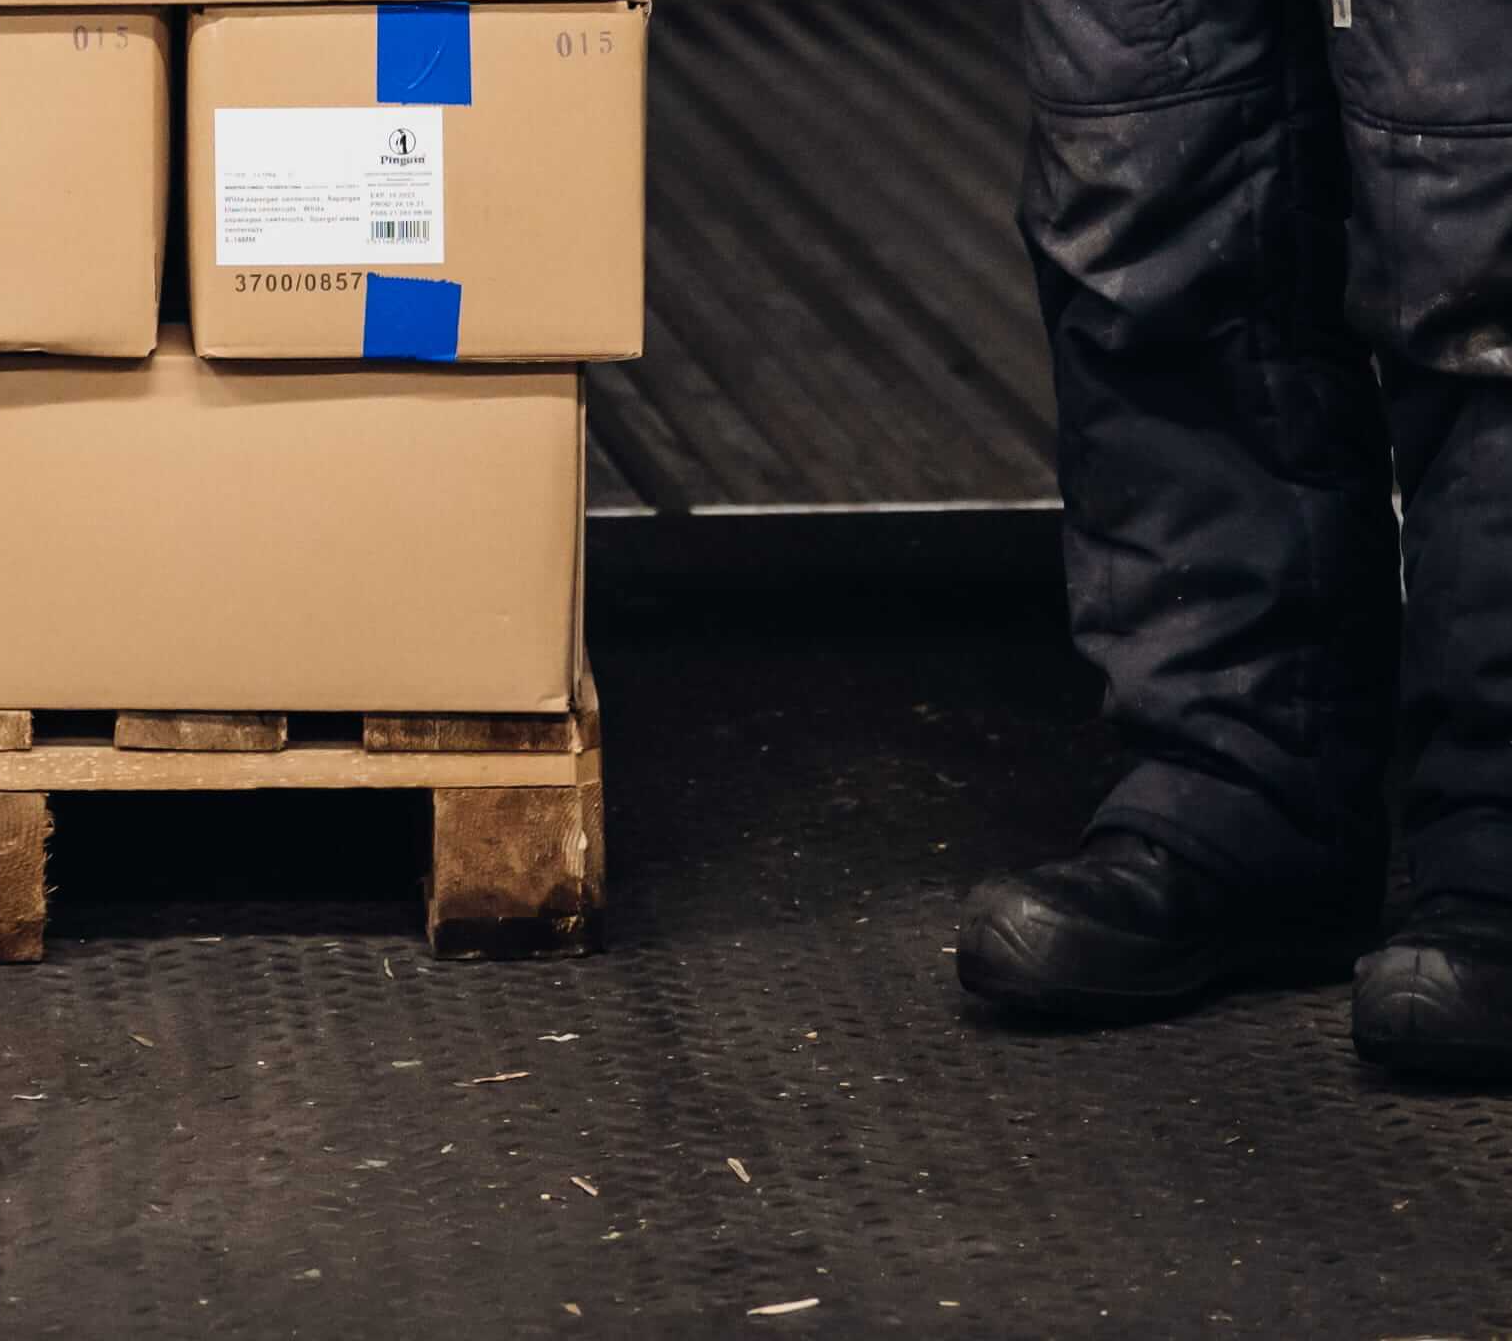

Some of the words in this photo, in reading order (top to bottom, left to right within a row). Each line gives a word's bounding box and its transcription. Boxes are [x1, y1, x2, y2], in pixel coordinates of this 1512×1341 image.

[72, 24, 129, 52] 015
[556, 30, 613, 59] 015
[380, 154, 425, 166] Pinguin
[234, 272, 363, 293] 3700/0857
